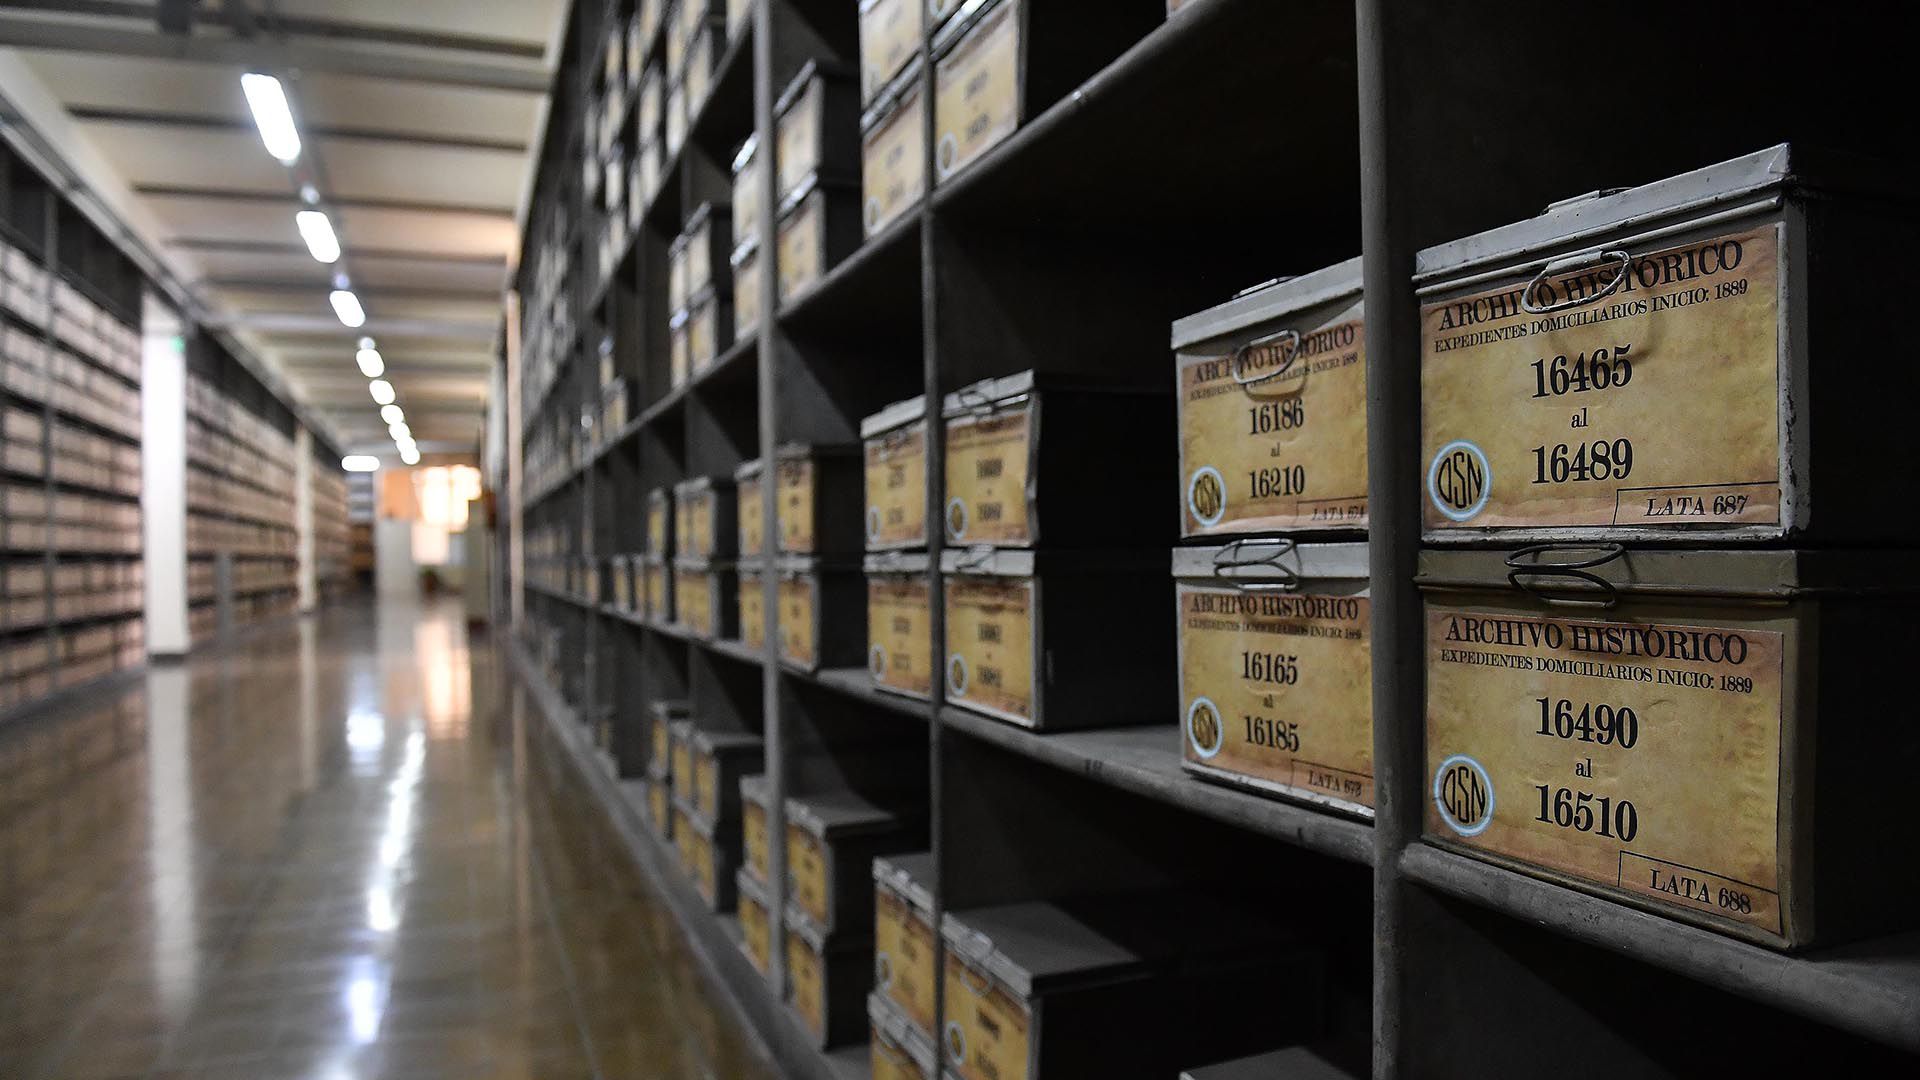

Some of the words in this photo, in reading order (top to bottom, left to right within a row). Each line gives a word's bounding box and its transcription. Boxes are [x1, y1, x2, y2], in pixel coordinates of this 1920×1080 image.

[1435, 322, 1527, 353] EXPEDIENTES
[1530, 299, 1648, 335] DOMICILIARIOS
[1651, 286, 1710, 313] INICIO:
[1714, 278, 1748, 299] 1889
[1531, 343, 1633, 398] 16465
[1249, 399, 1304, 435] 16186
[1571, 408, 1588, 428] al
[1270, 442, 1281, 457] al
[1531, 438, 1633, 484] 16489
[1249, 465, 1305, 499] 16210
[1437, 452, 1482, 509] OSN
[1643, 497, 1705, 517] LATA
[1712, 494, 1749, 515] 687
[1445, 617, 1563, 650] ARCHIVO
[1567, 624, 1747, 665] HISTÓRICO
[1242, 652, 1298, 685] 16165
[1441, 649, 1533, 670] EXPEDIENTES
[1535, 657, 1652, 683] DOMICILIARIOS
[1656, 668, 1715, 690] INICIO:
[1719, 675, 1753, 694] 1889
[1263, 694, 1274, 708] al
[1536, 697, 1638, 749] 16490
[1244, 715, 1300, 752] 16185
[1575, 759, 1592, 778] al
[1442, 766, 1486, 824] OSN
[1535, 784, 1638, 843] 16510
[1650, 868, 1712, 905] LATA
[1719, 887, 1752, 915] 688
